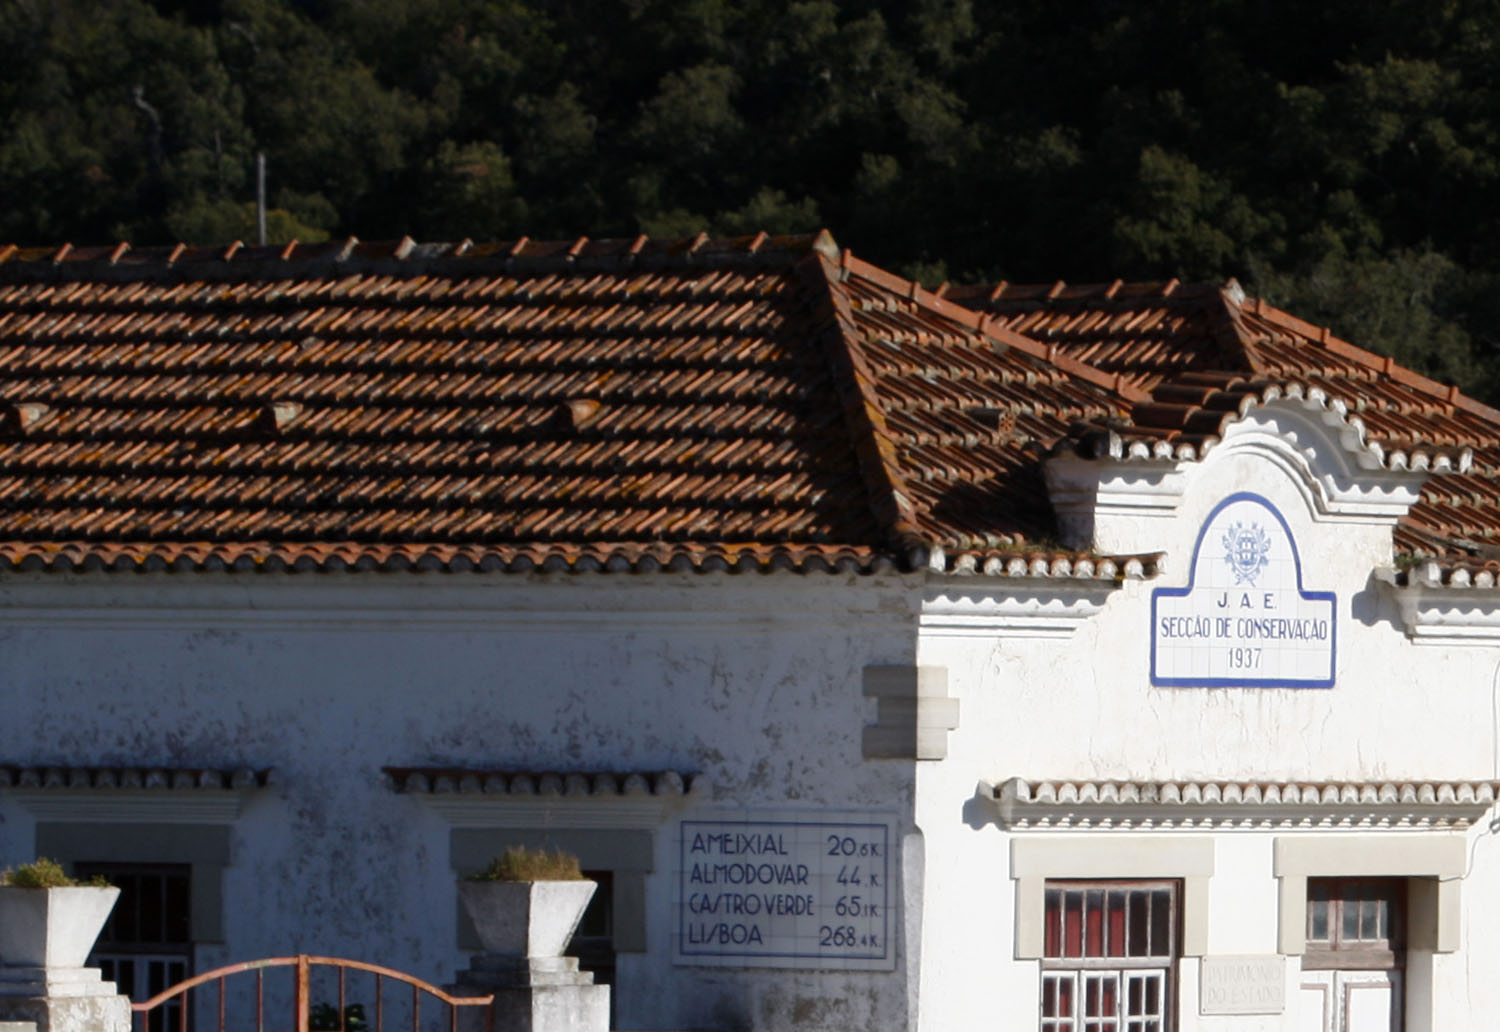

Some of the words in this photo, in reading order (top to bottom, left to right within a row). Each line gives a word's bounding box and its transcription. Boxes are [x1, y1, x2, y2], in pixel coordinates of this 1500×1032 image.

[1216, 617, 1232, 638] DE
[1229, 648, 1262, 668] 1937
[690, 833, 788, 855] AMEIXIAL
[690, 864, 809, 885] ALMODOVAR
[689, 893, 762, 915] CASTRO
[763, 894, 814, 915] VERDE
[688, 923, 763, 945] LISBOA
